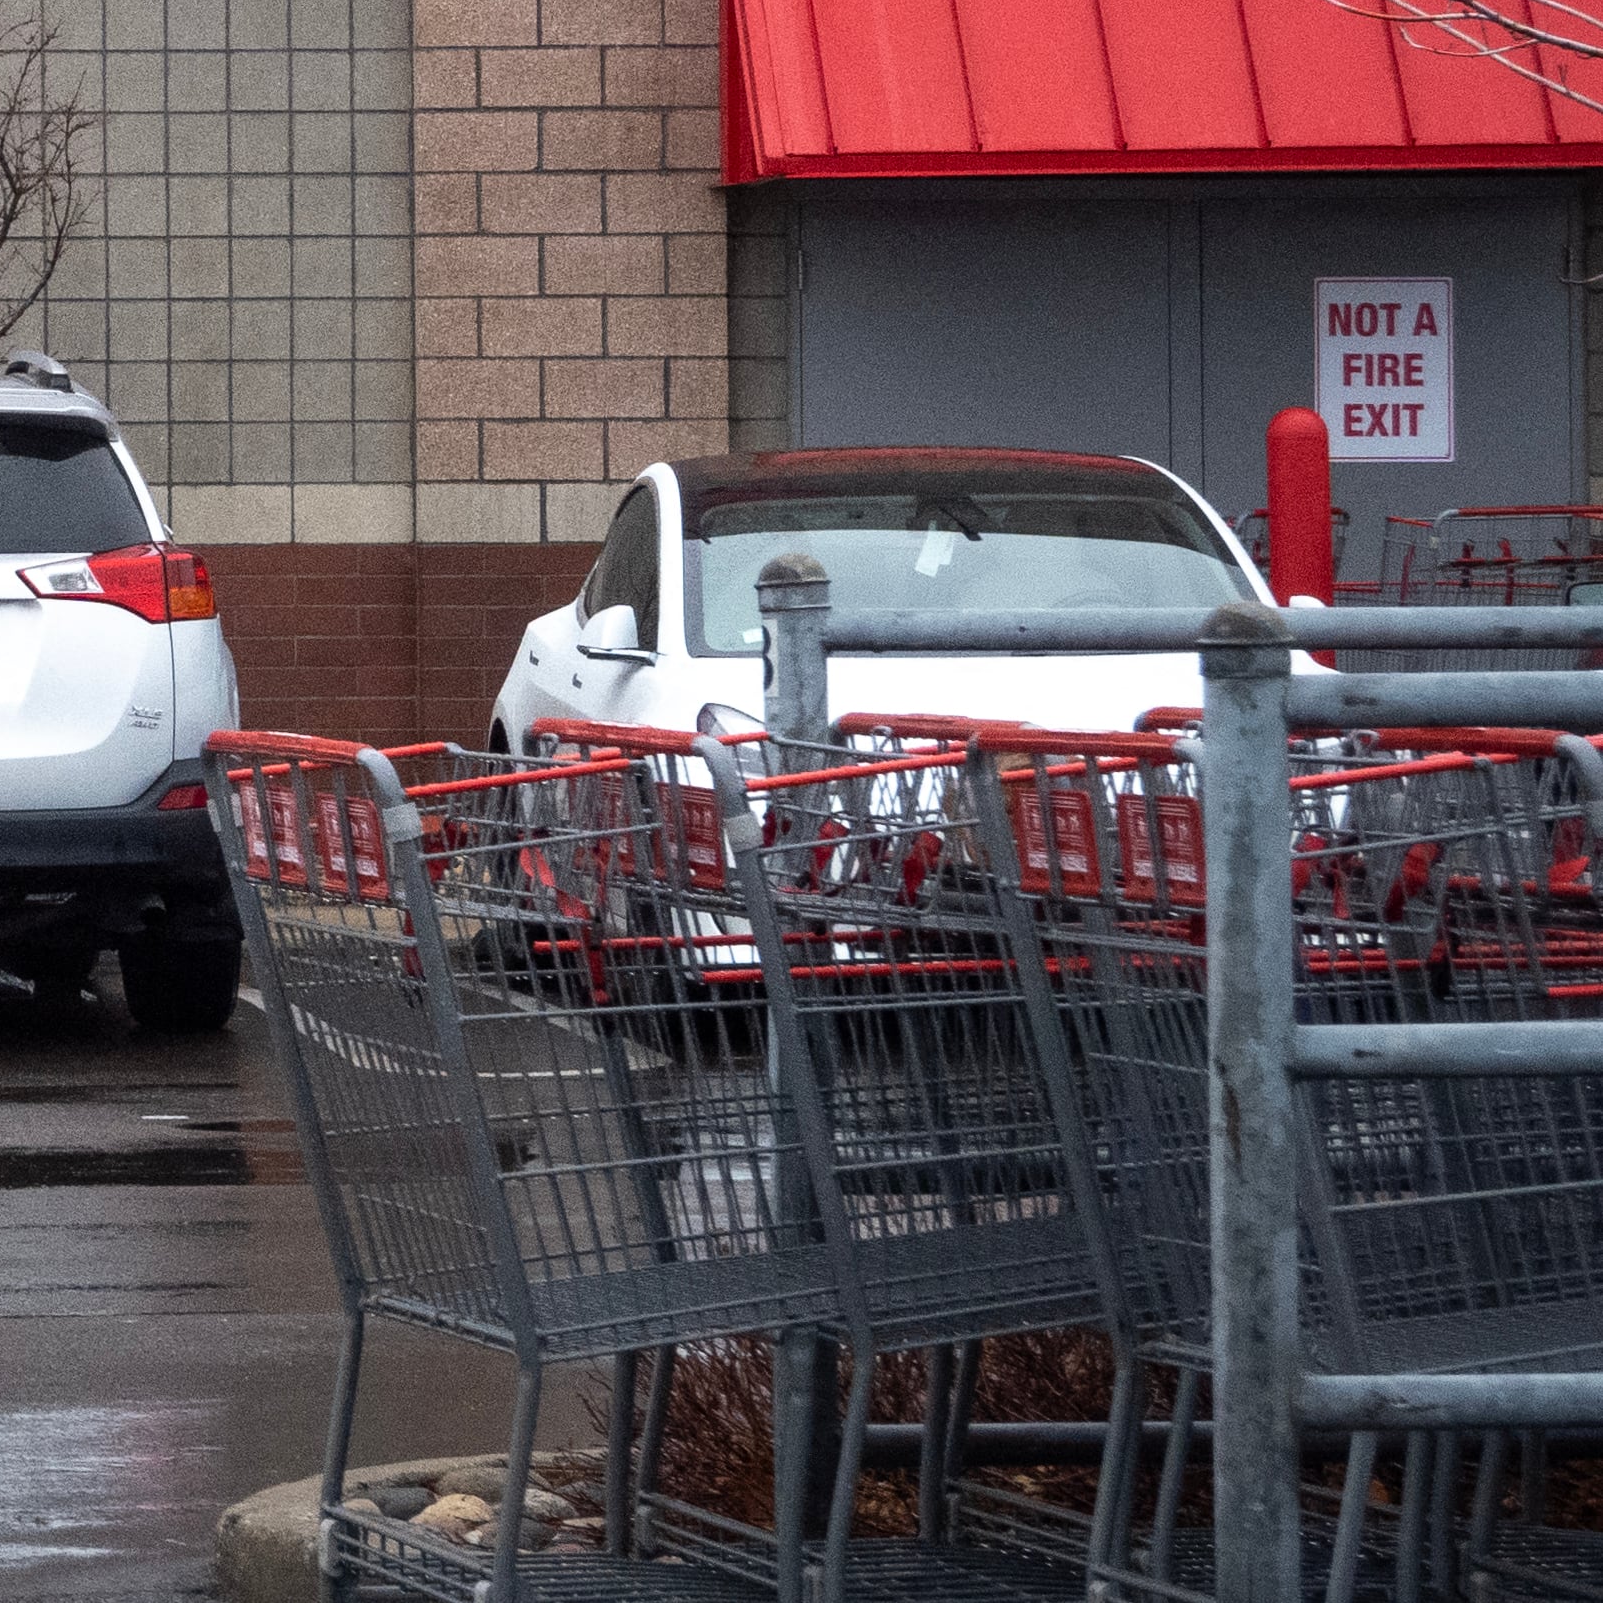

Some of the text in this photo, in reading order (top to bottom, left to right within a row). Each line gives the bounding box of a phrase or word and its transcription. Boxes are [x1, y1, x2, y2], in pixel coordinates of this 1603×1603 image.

[1327, 302, 1438, 337] NOT A
[1343, 353, 1425, 387] FIRE
[1343, 403, 1425, 437] EXIT
